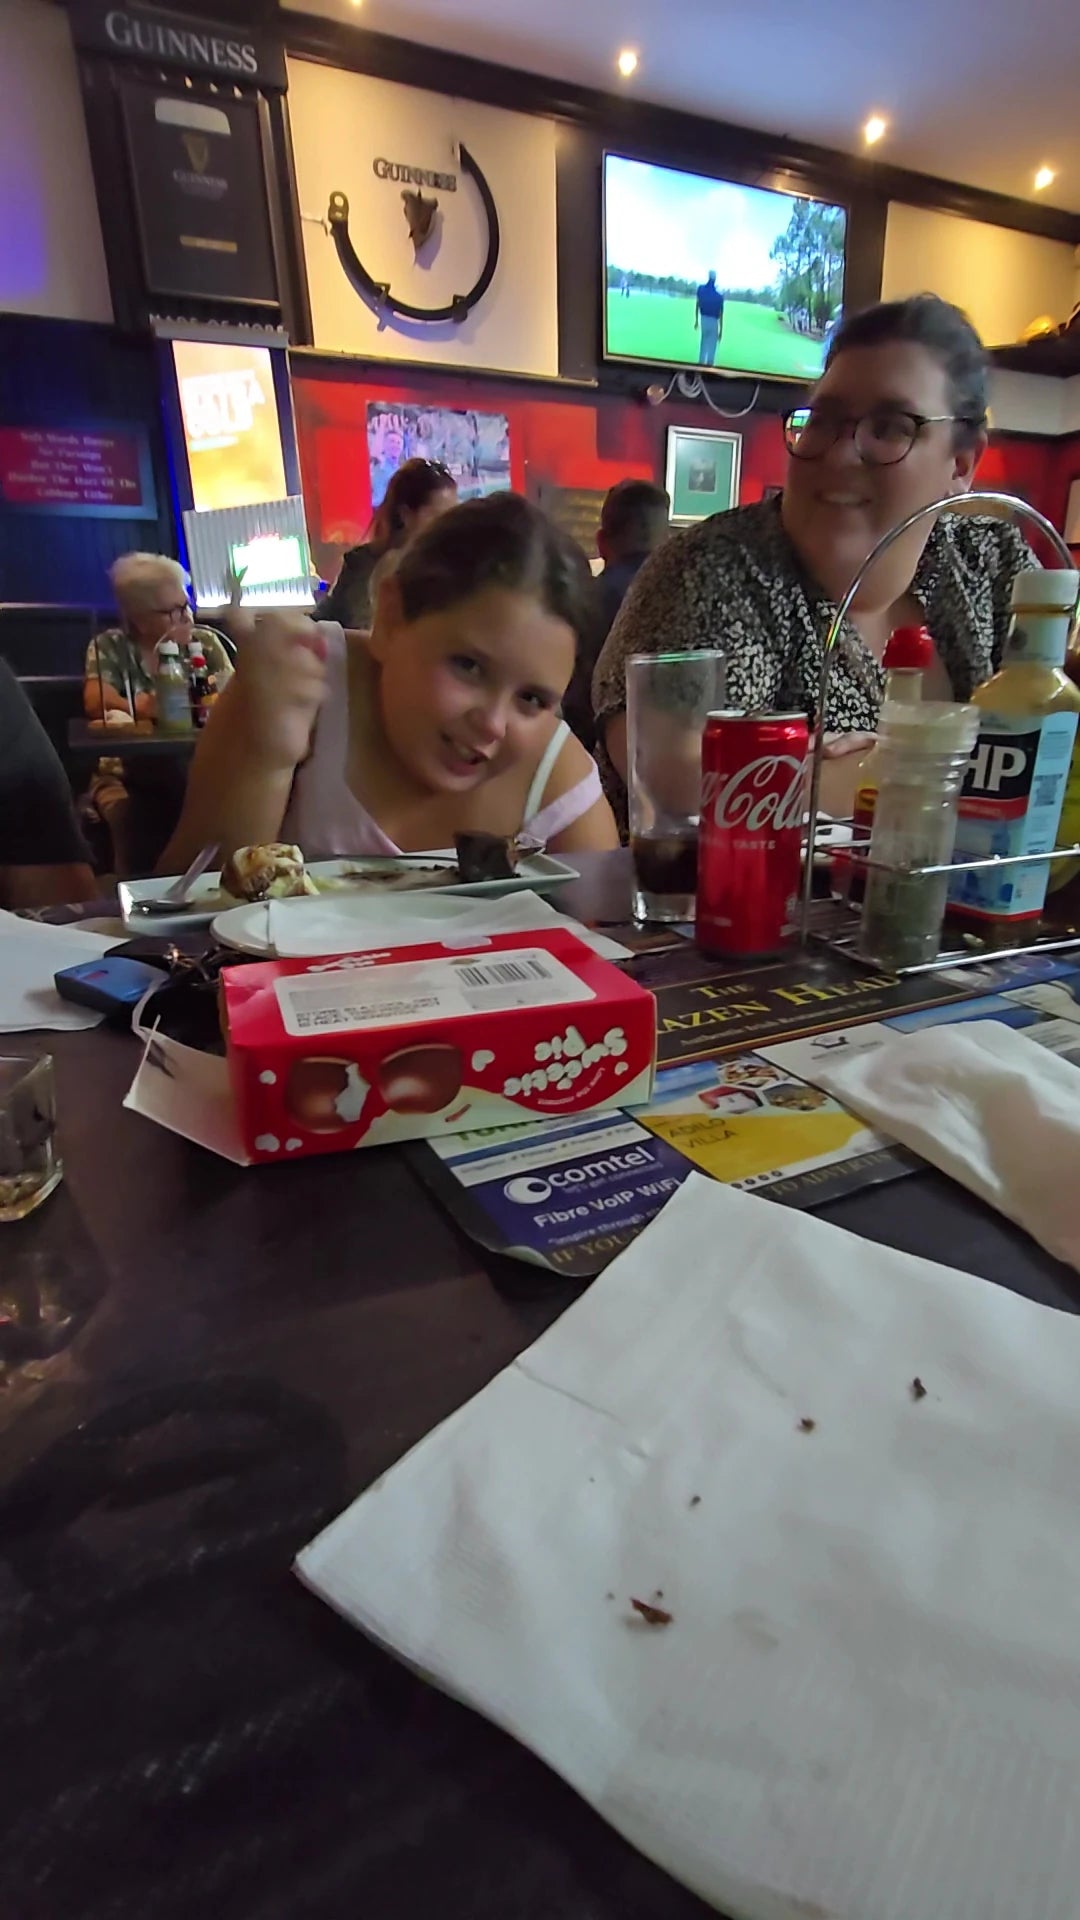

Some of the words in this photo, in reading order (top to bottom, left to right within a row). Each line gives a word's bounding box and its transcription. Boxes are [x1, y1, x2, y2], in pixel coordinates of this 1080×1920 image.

[104, 10, 258, 74] GUINNESS
[372, 157, 457, 193] GUINNESS
[962, 743, 1027, 792] HP
[655, 1000, 772, 1034] AZEN
[503, 1026, 628, 1097] Sweetie
[668, 1117, 726, 1138] ADILO
[682, 1129, 738, 1149] VILLA
[548, 1145, 656, 1188] comtel
[532, 1206, 590, 1229] Fibre
[551, 1247, 576, 1264] IF
